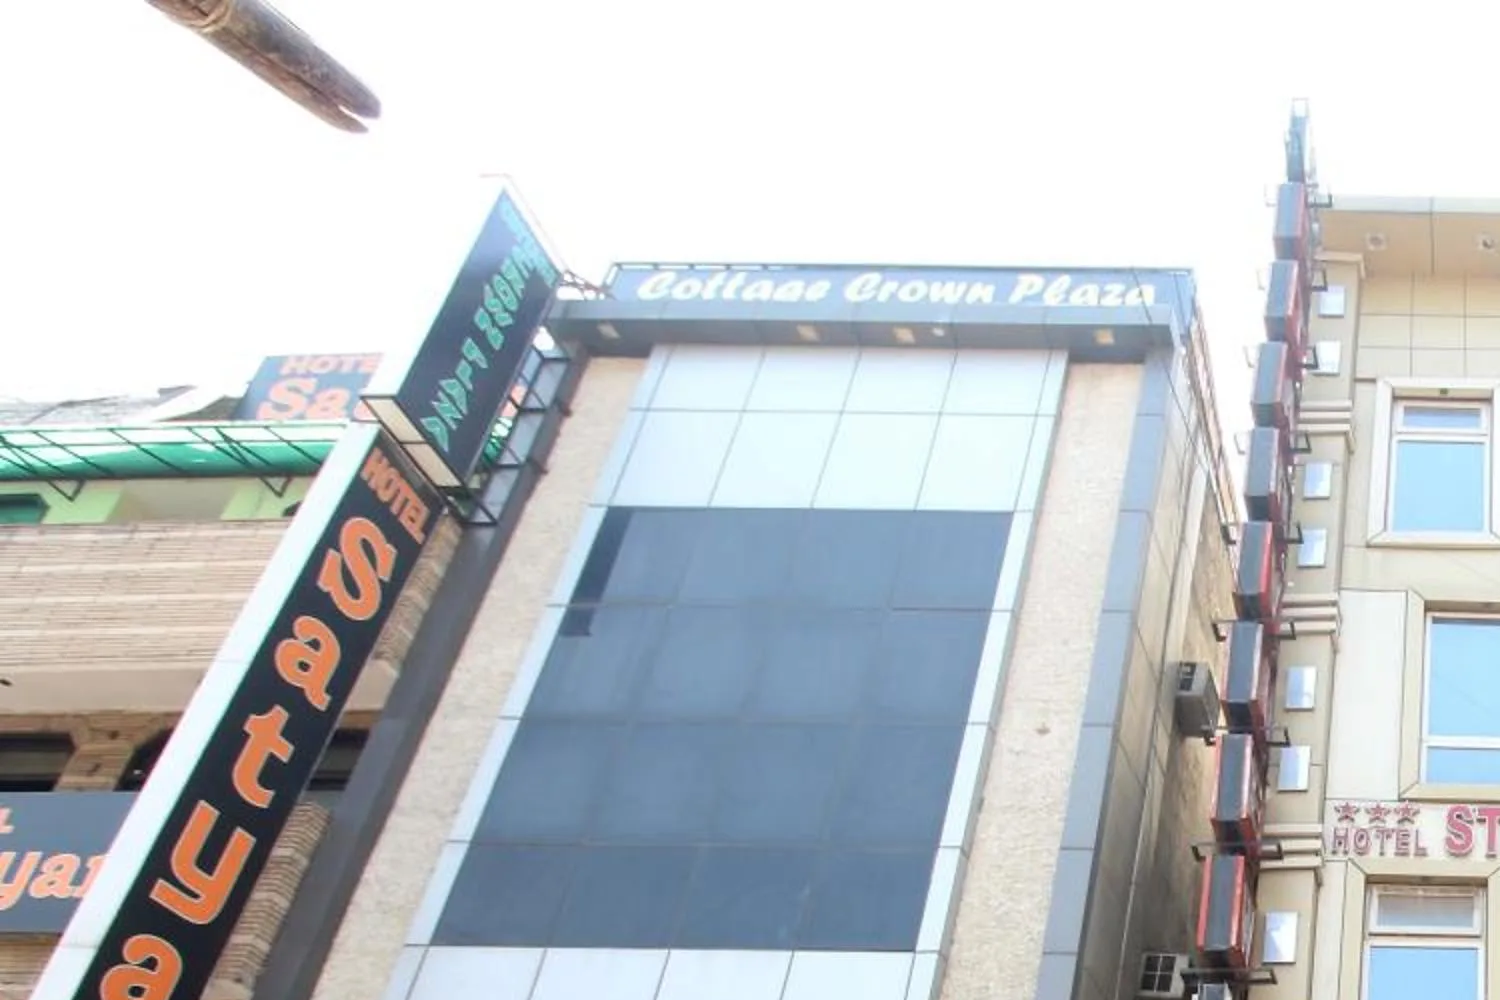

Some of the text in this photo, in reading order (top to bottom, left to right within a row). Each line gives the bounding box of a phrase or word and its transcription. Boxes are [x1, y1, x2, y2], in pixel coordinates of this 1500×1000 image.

[843, 273, 996, 305] Crown
[1009, 275, 1156, 308] Plaza
[280, 354, 382, 374] HOTE
[360, 448, 431, 545] HOTEL
[1331, 827, 1429, 857] HOTEL
